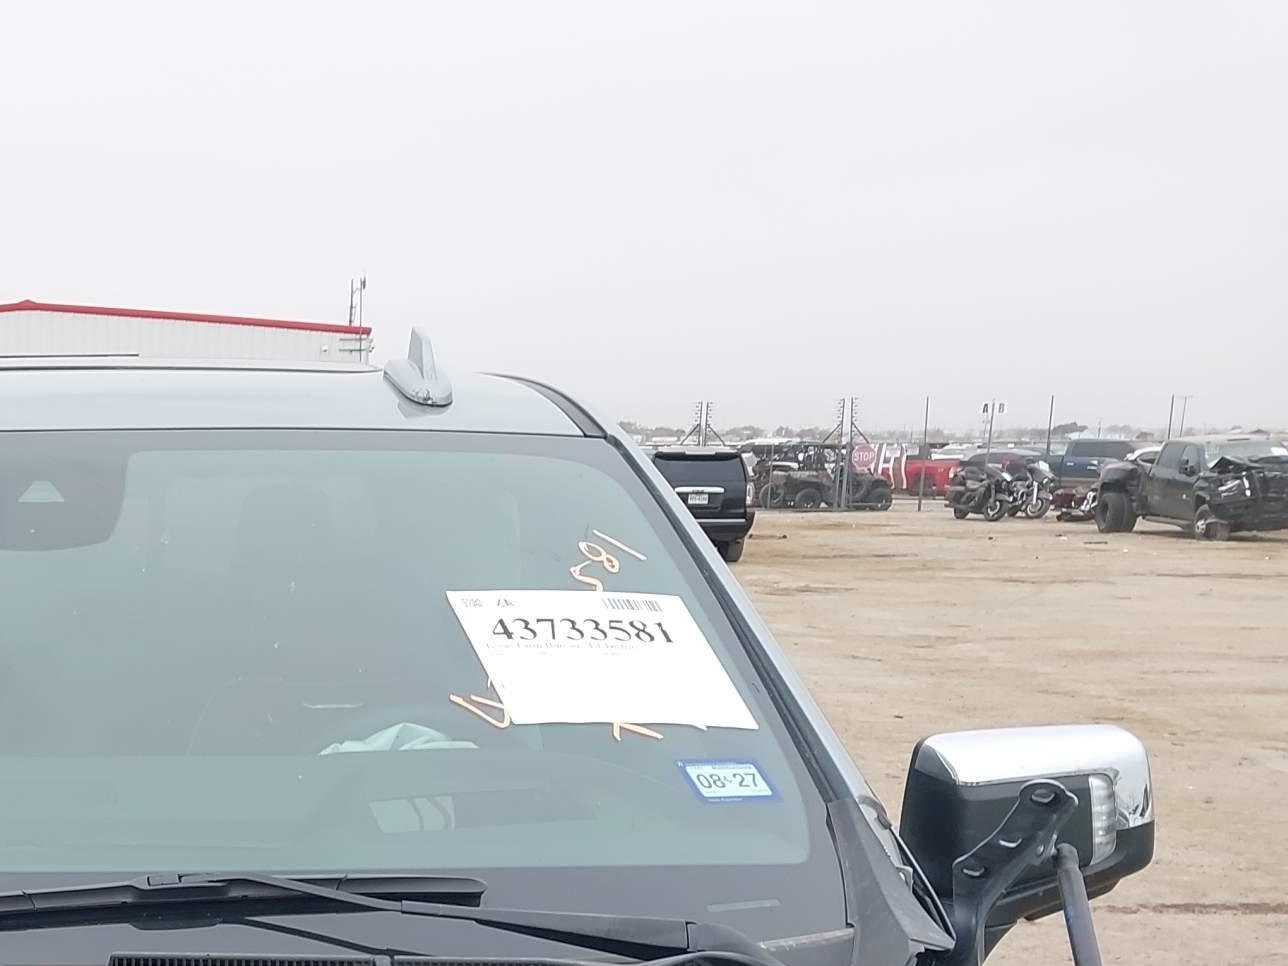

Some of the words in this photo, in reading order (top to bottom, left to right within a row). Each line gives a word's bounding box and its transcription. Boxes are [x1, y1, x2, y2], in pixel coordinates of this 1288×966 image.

[982, 403, 989, 414] A
[998, 403, 1005, 414] B
[854, 450, 875, 463] STOP
[492, 617, 675, 644] 43733581
[696, 773, 726, 789] 08
[732, 772, 758, 788] 27
